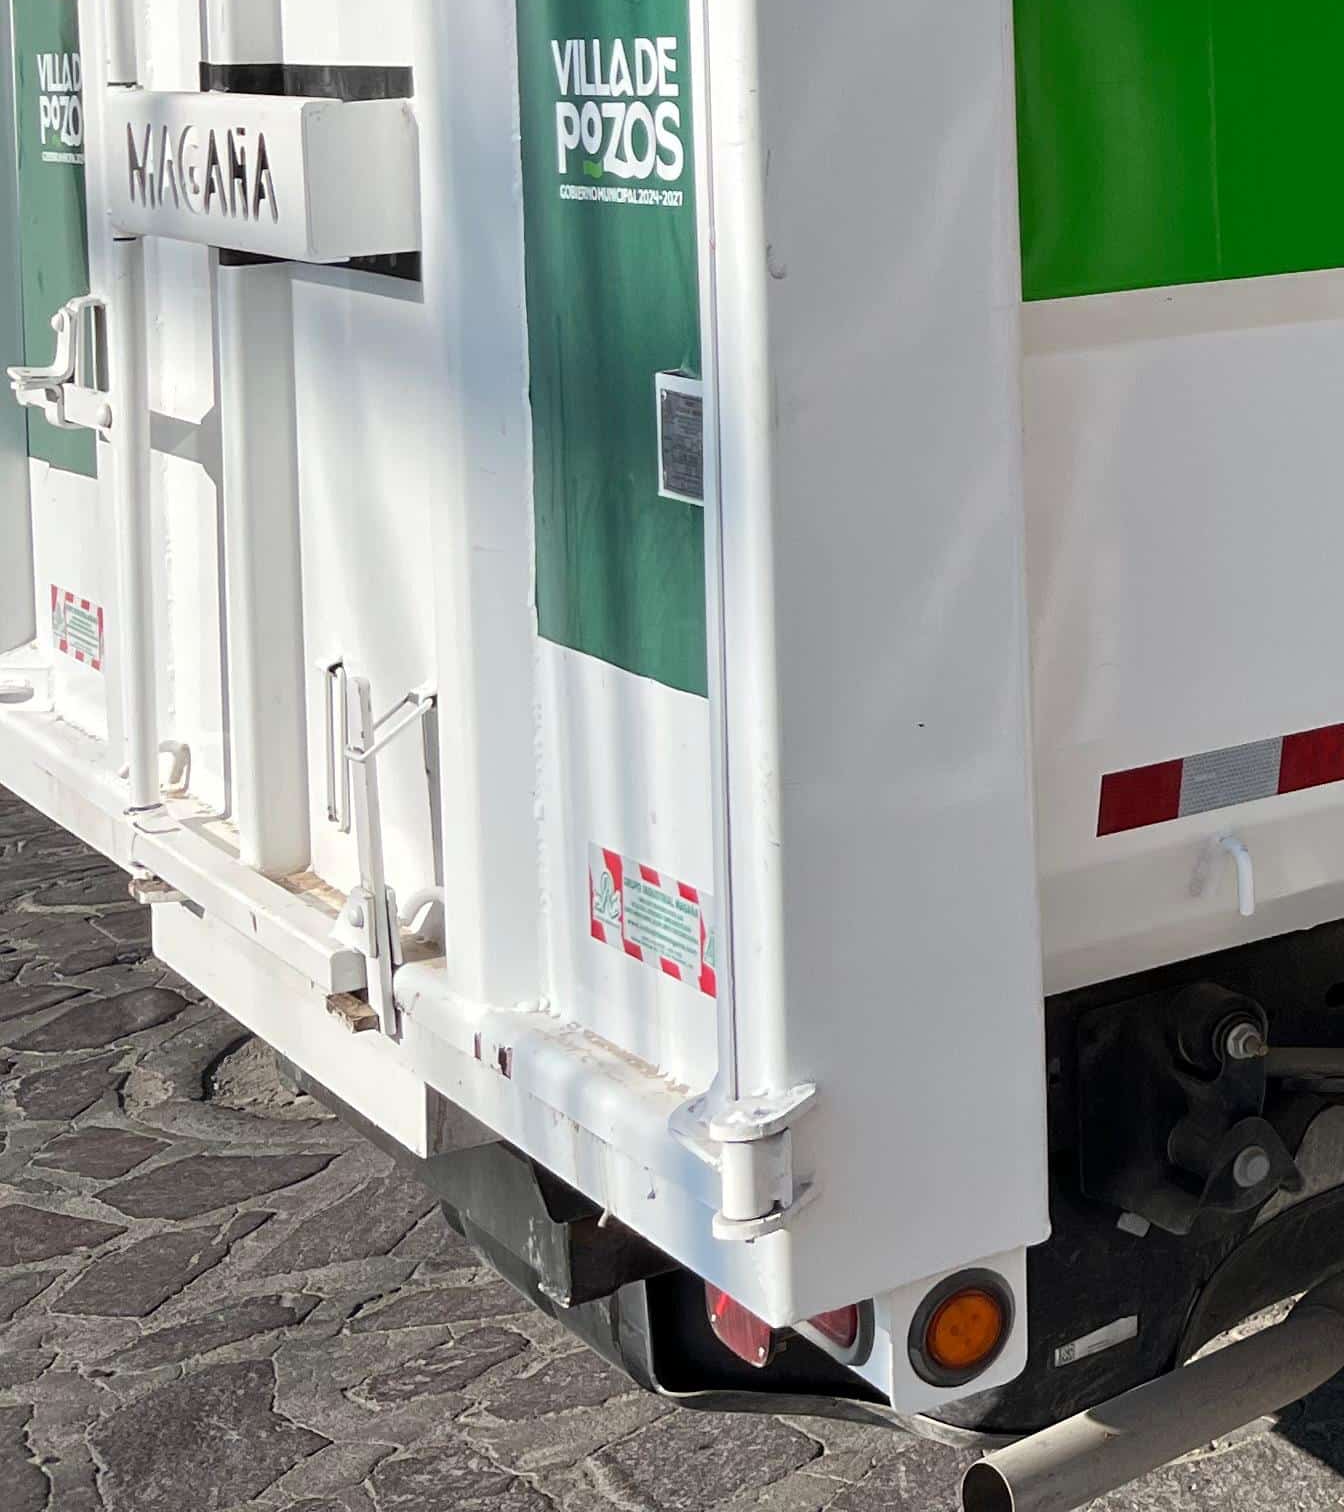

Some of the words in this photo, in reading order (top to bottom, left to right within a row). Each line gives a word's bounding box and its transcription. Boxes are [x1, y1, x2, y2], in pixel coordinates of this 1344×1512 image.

[37, 52, 72, 92] VILLA
[551, 38, 634, 97] VILLA
[634, 36, 679, 97] DE
[40, 95, 82, 147] POZO
[555, 100, 684, 181] POZOS
